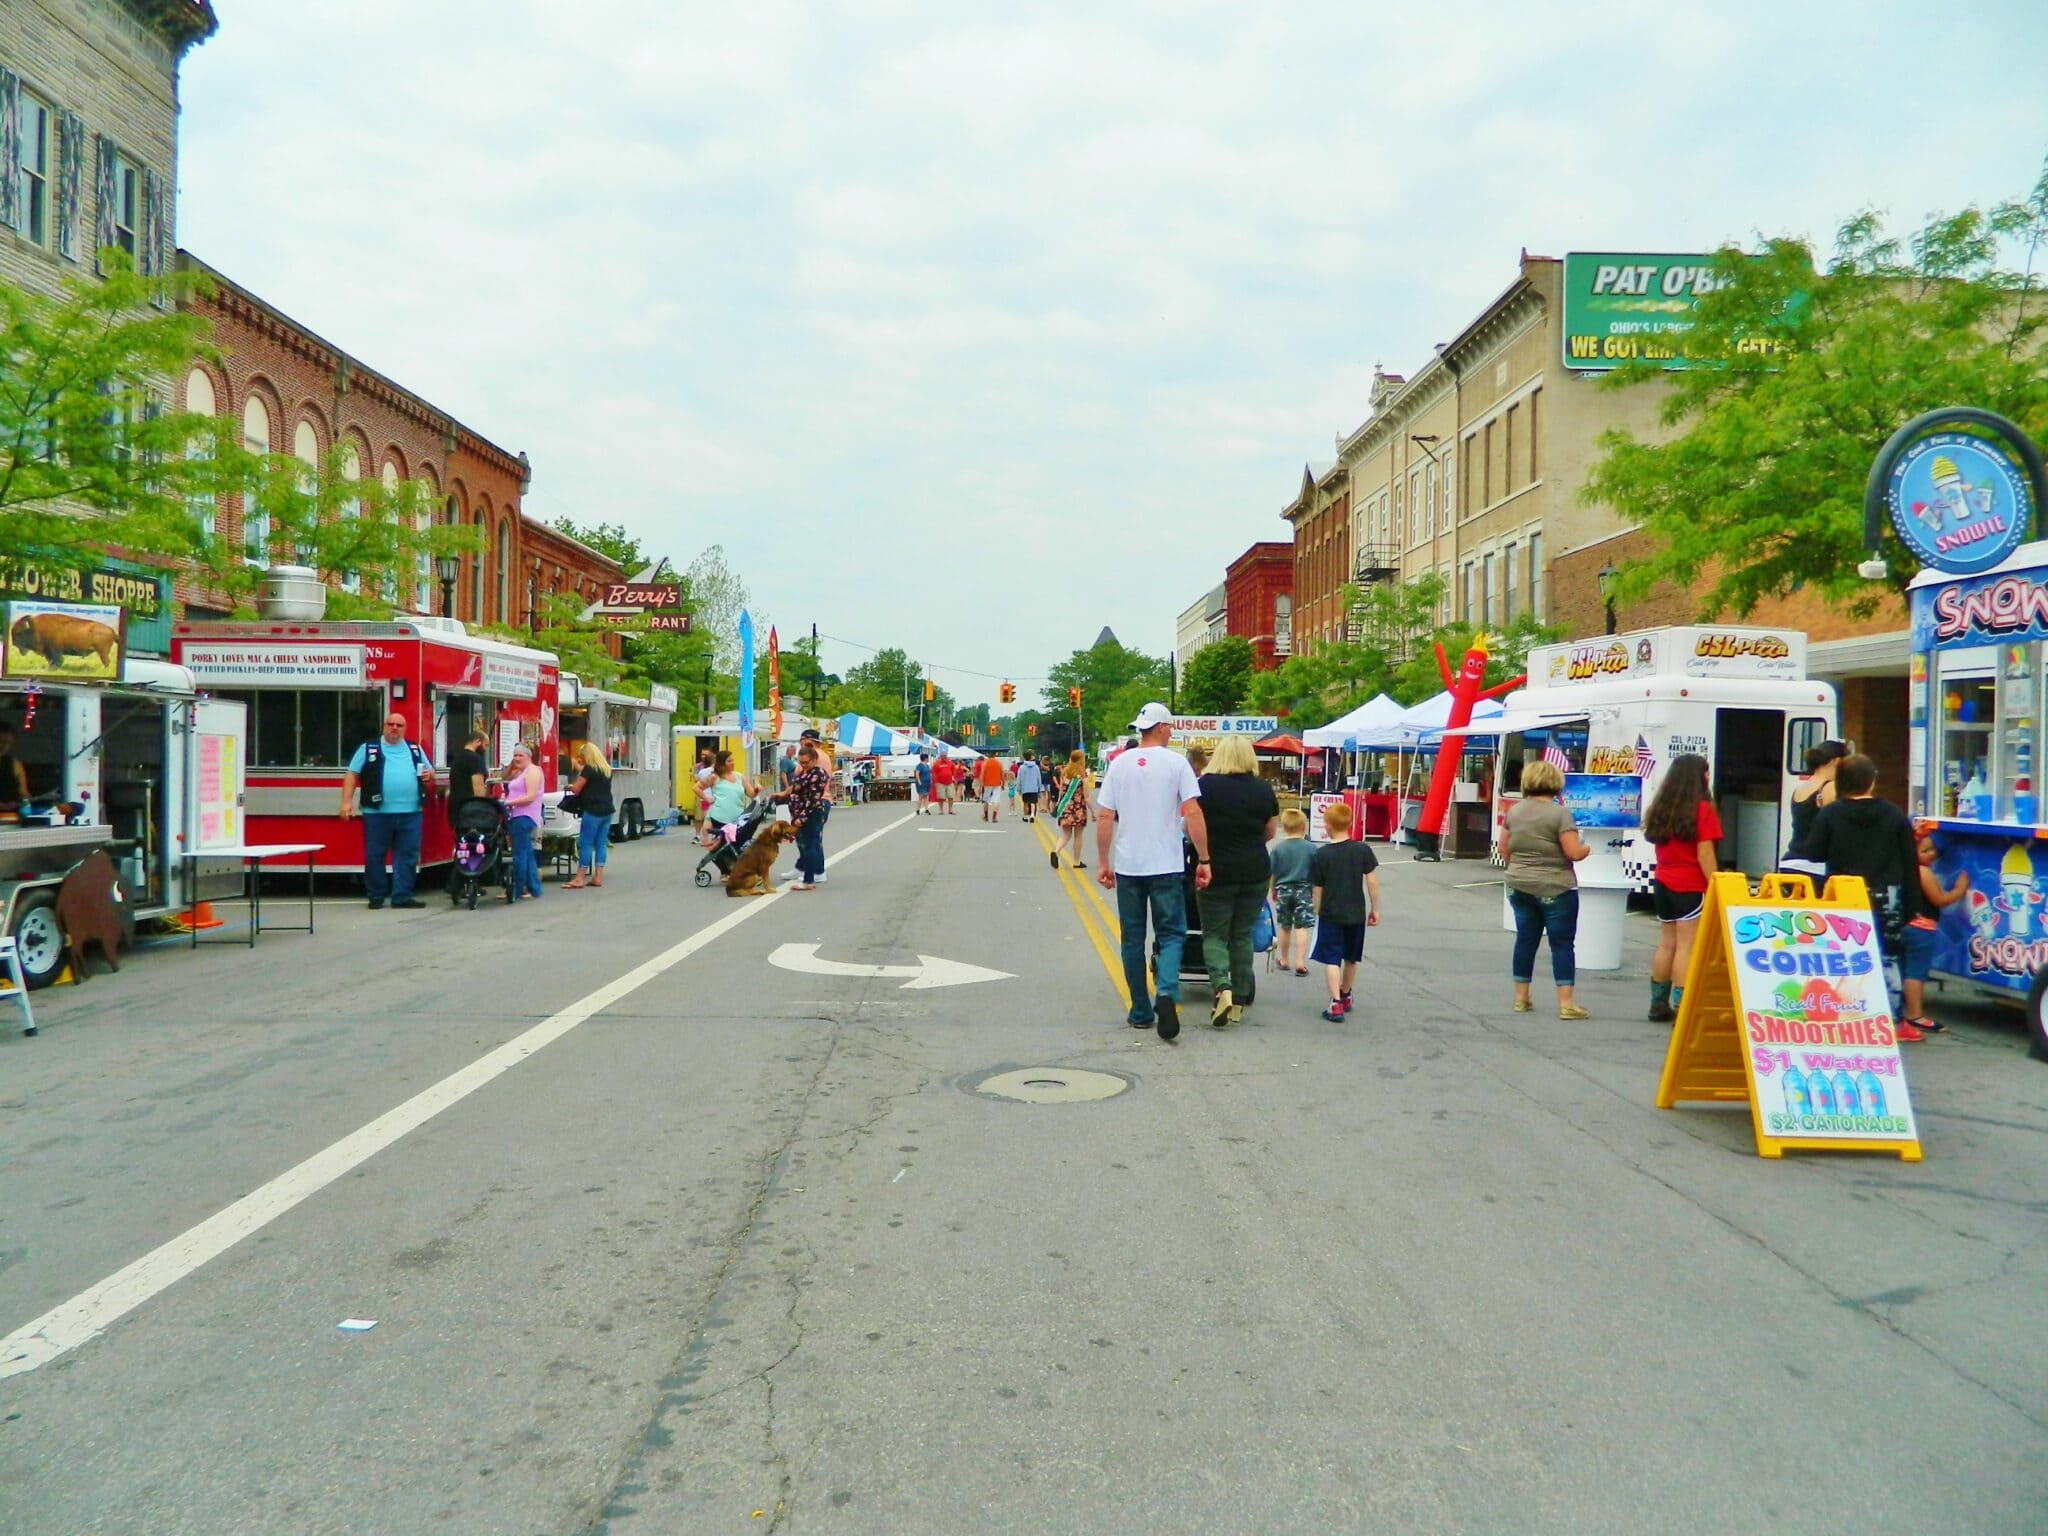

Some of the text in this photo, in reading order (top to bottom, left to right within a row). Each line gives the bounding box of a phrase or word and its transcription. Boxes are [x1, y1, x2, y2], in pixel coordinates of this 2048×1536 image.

[1592, 265, 1657, 295] PAT
[1609, 321, 1650, 334] OHIO'S
[1571, 336, 1598, 360] WE
[1603, 336, 1638, 359] GOT
[1936, 515, 2006, 553] SNOWIE
[92, 573, 156, 613] SHOPPE
[607, 584, 678, 608] Berry's
[1695, 634, 1789, 658] CSL Pizza
[192, 653, 352, 664] PORKY LOVES MAC & CHEESE SANDWICHES
[1567, 646, 1629, 680] CSL Pizza
[1169, 719, 1275, 731] AUSAGE & STEAK
[1671, 735, 1706, 745] CSL PIZZA
[1735, 911, 1872, 946] SNOW
[1746, 949, 1873, 976] CONES
[1774, 993, 1868, 1012] Real Fruit
[1747, 1011, 1894, 1046] SMOOTHIES
[1753, 1047, 1791, 1077] $1
[1770, 1114, 1908, 1133] $2 GATORADE
